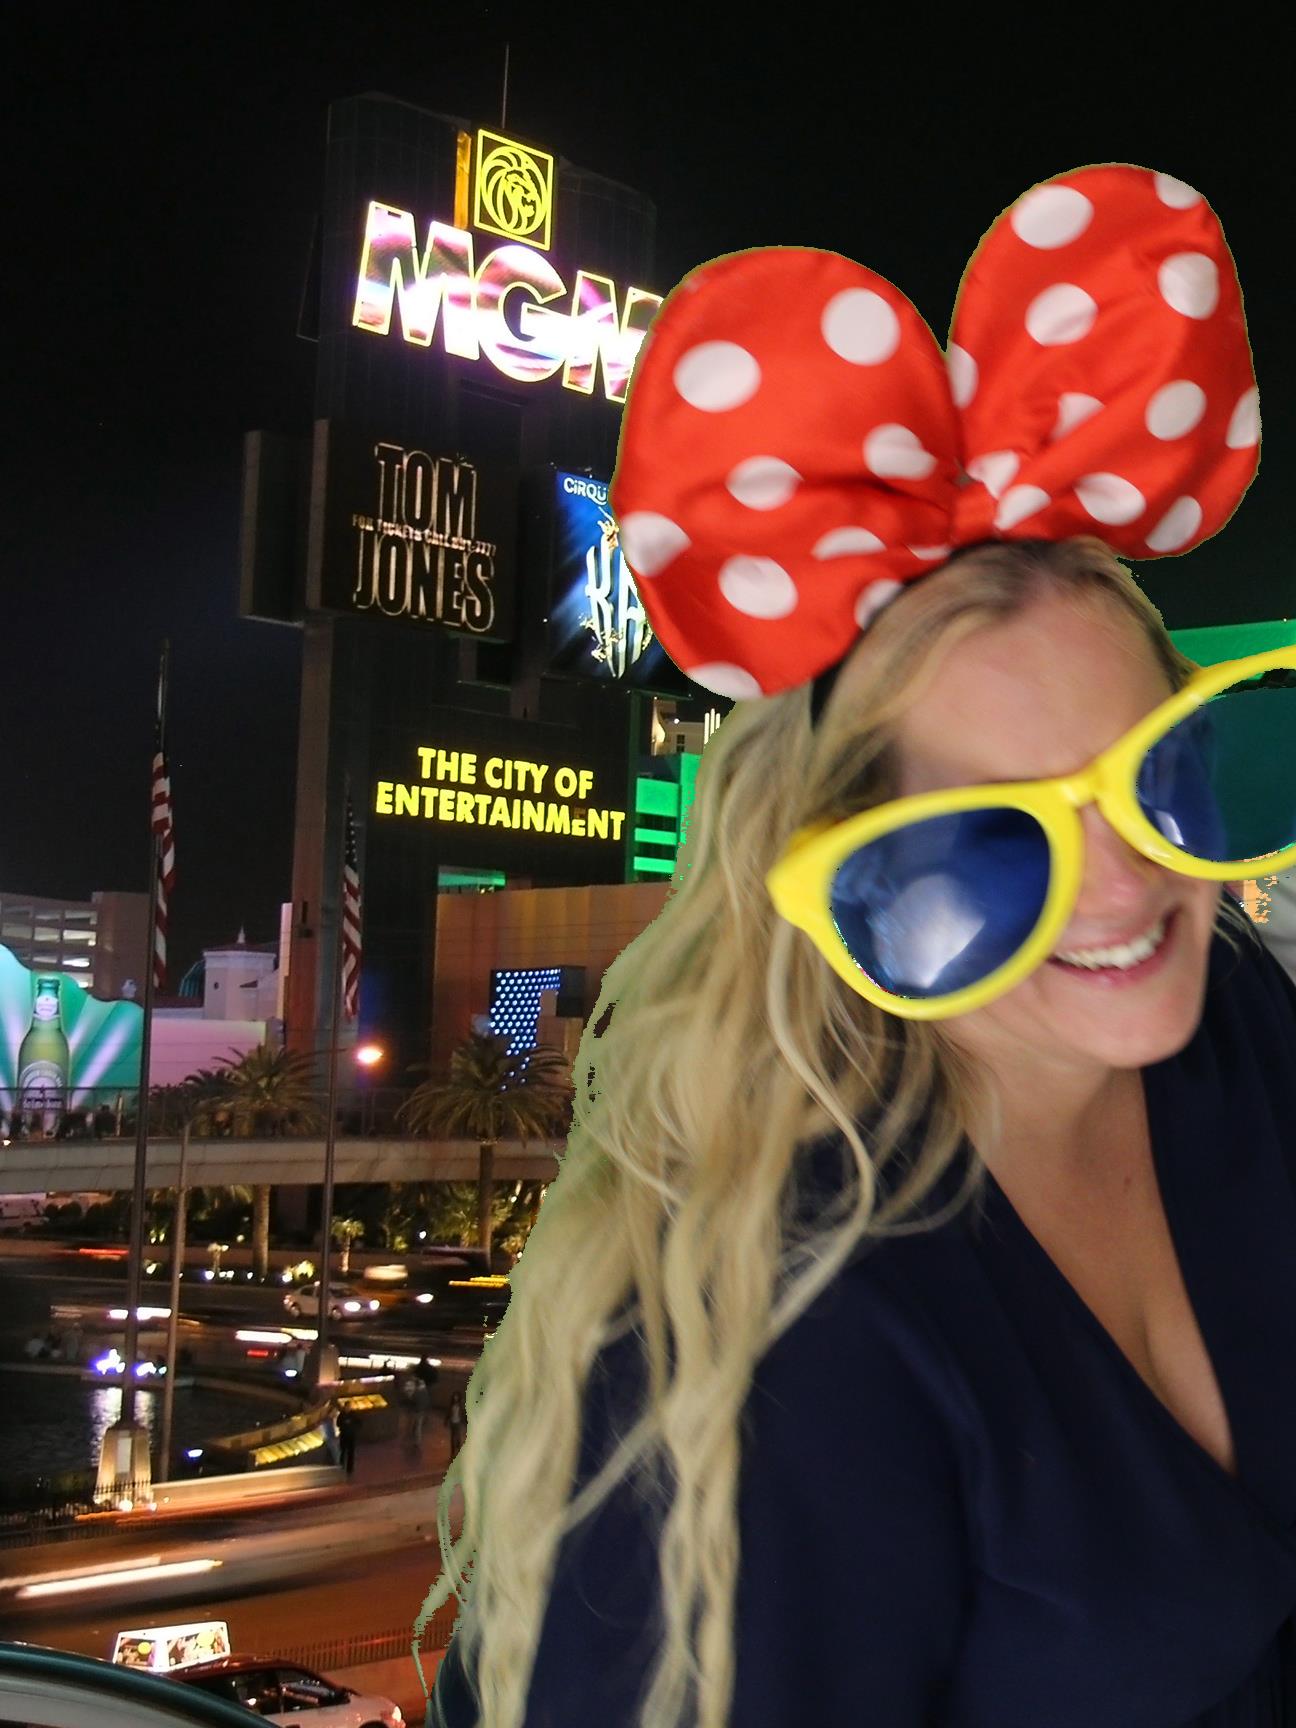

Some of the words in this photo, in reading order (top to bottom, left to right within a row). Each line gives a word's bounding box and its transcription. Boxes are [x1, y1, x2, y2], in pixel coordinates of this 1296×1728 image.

[374, 441, 477, 540] TOM
[352, 530, 495, 632] JONES
[376, 780, 626, 841] ENTERTAINMENT
[417, 746, 477, 785] THE
[484, 757, 549, 794] CITY
[554, 766, 594, 800] OF
